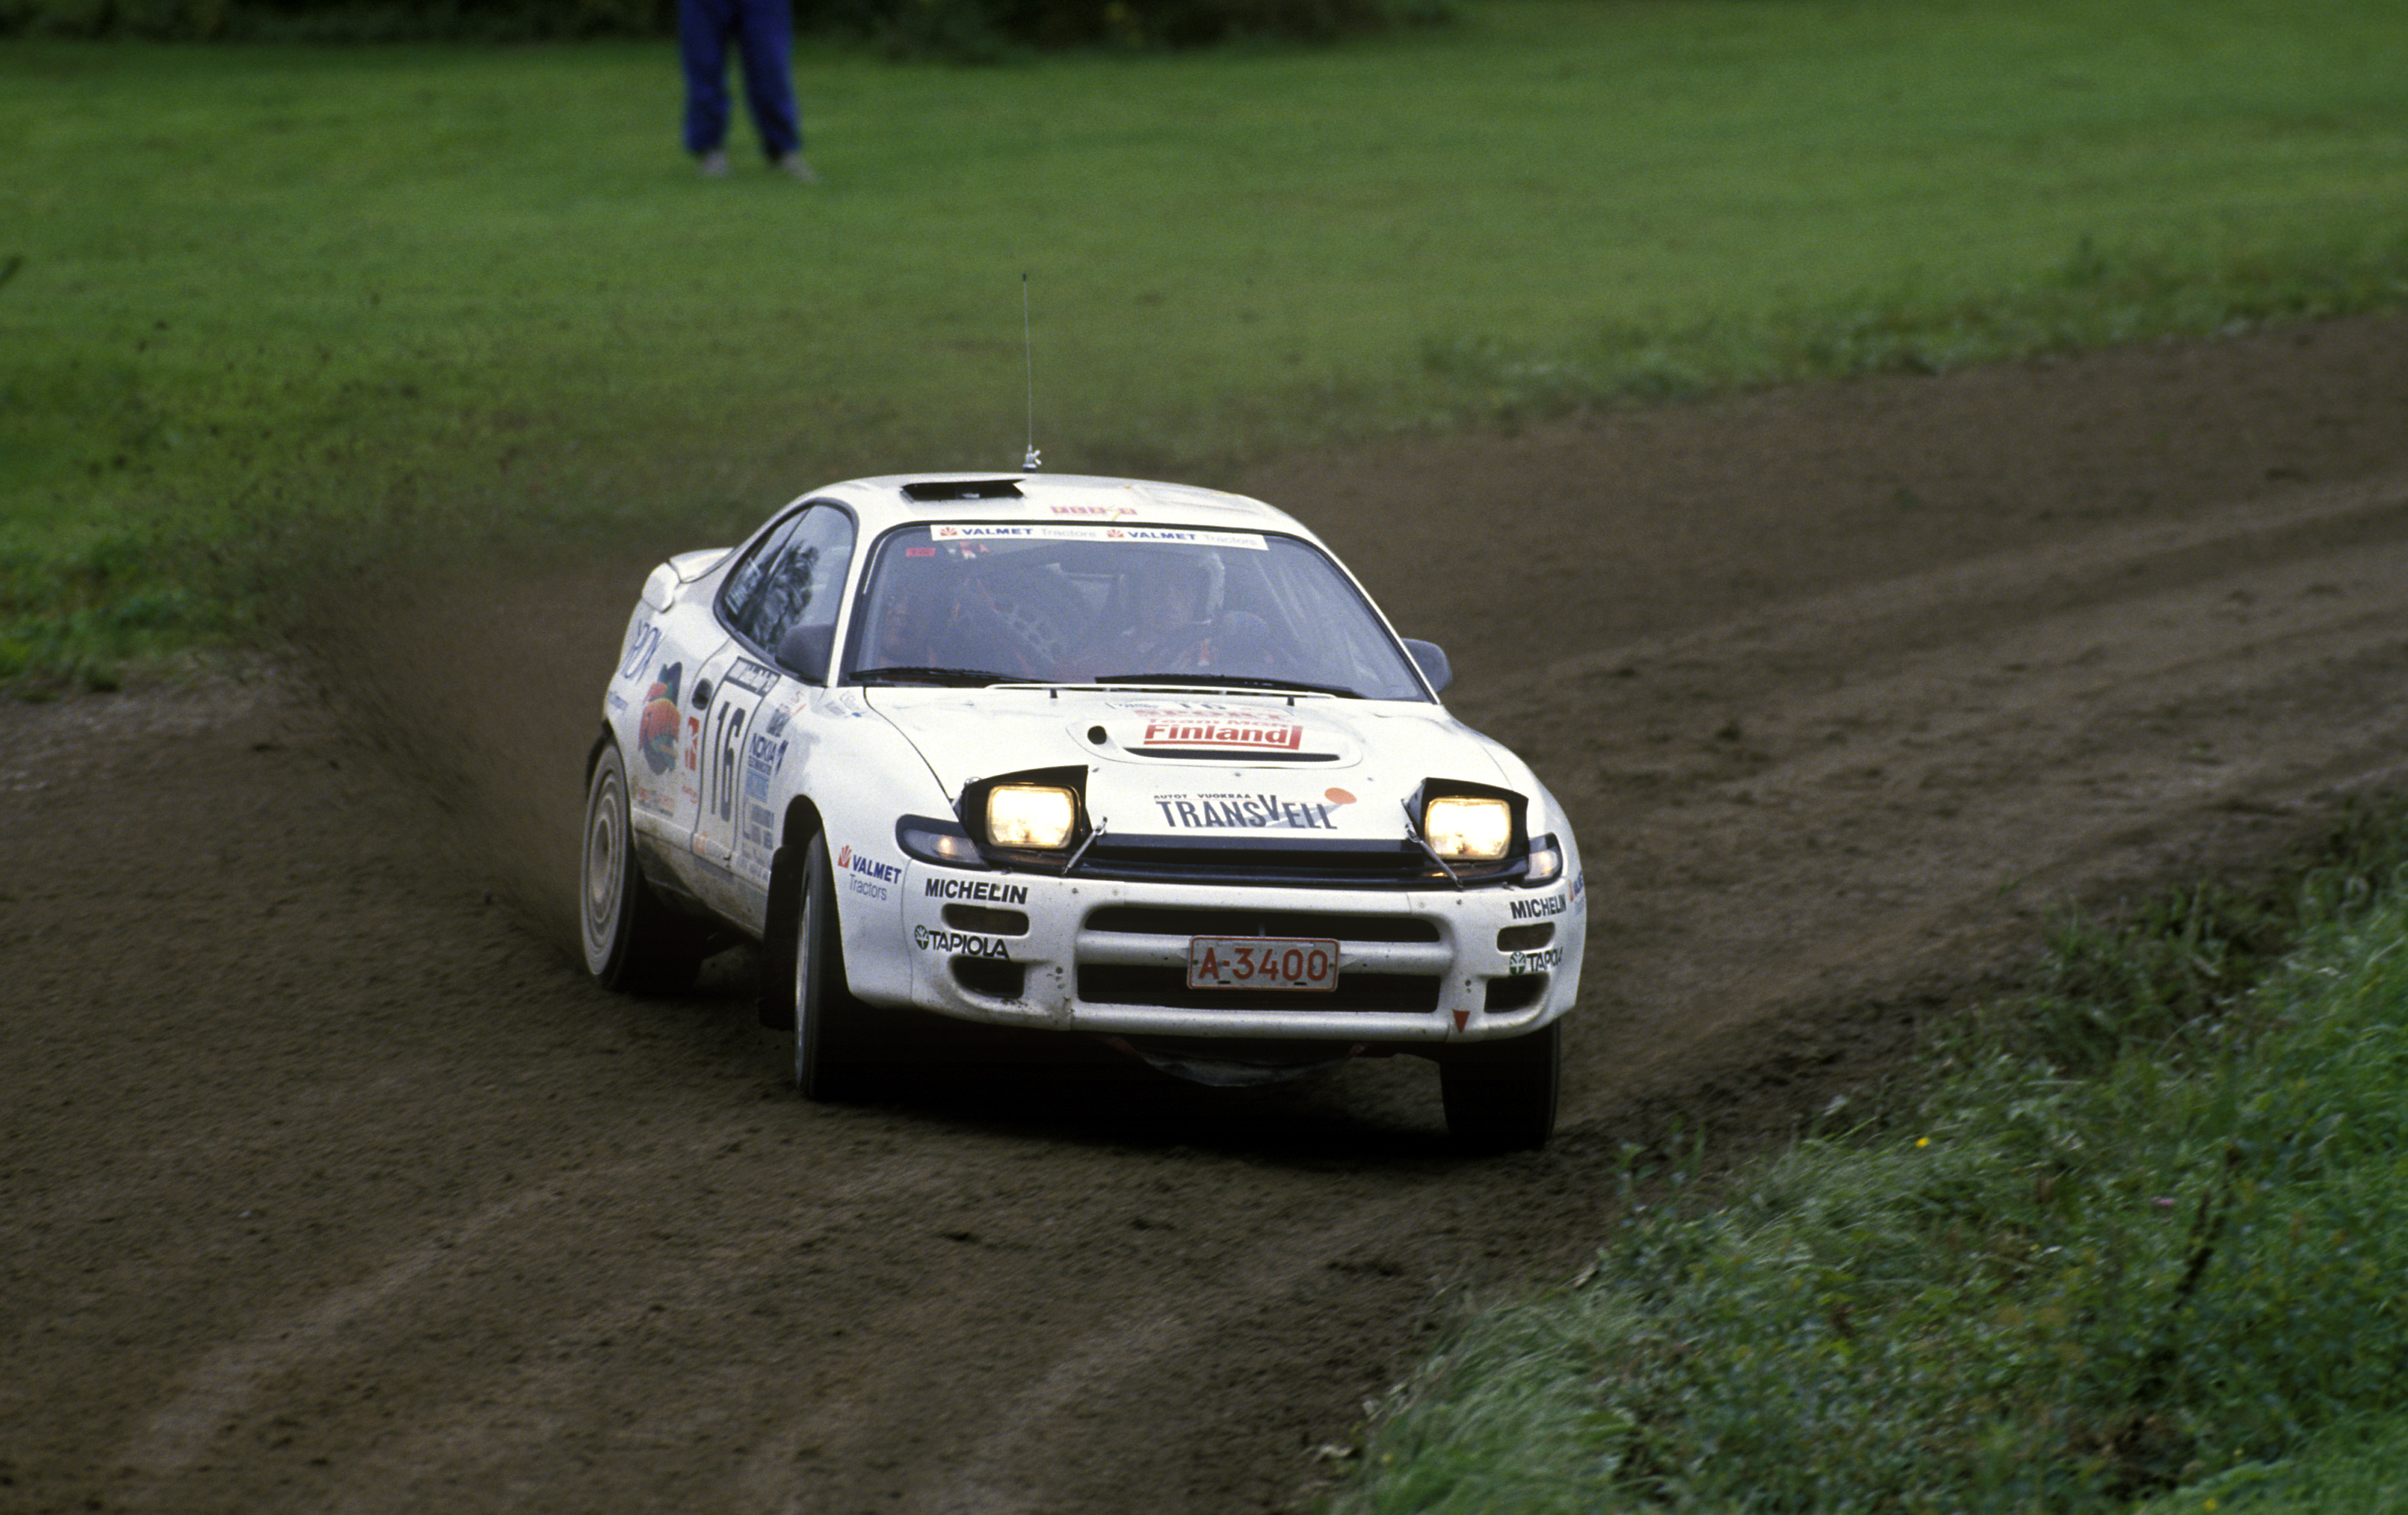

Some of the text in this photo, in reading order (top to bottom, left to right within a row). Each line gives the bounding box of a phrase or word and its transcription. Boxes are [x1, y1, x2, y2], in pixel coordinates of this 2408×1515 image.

[1128, 532, 1196, 541] VALMET
[1144, 724, 1287, 743] Finland
[711, 701, 746, 822] 16
[1156, 794, 1338, 829] TRANSVELL
[852, 855, 902, 884] VALMET
[848, 874, 887, 900] Tractors
[925, 878, 1028, 904] MICHELIN
[1510, 894, 1567, 919] MICHELIN
[927, 930, 1010, 960] TAPIOLA
[1198, 947, 1328, 981] A-3400
